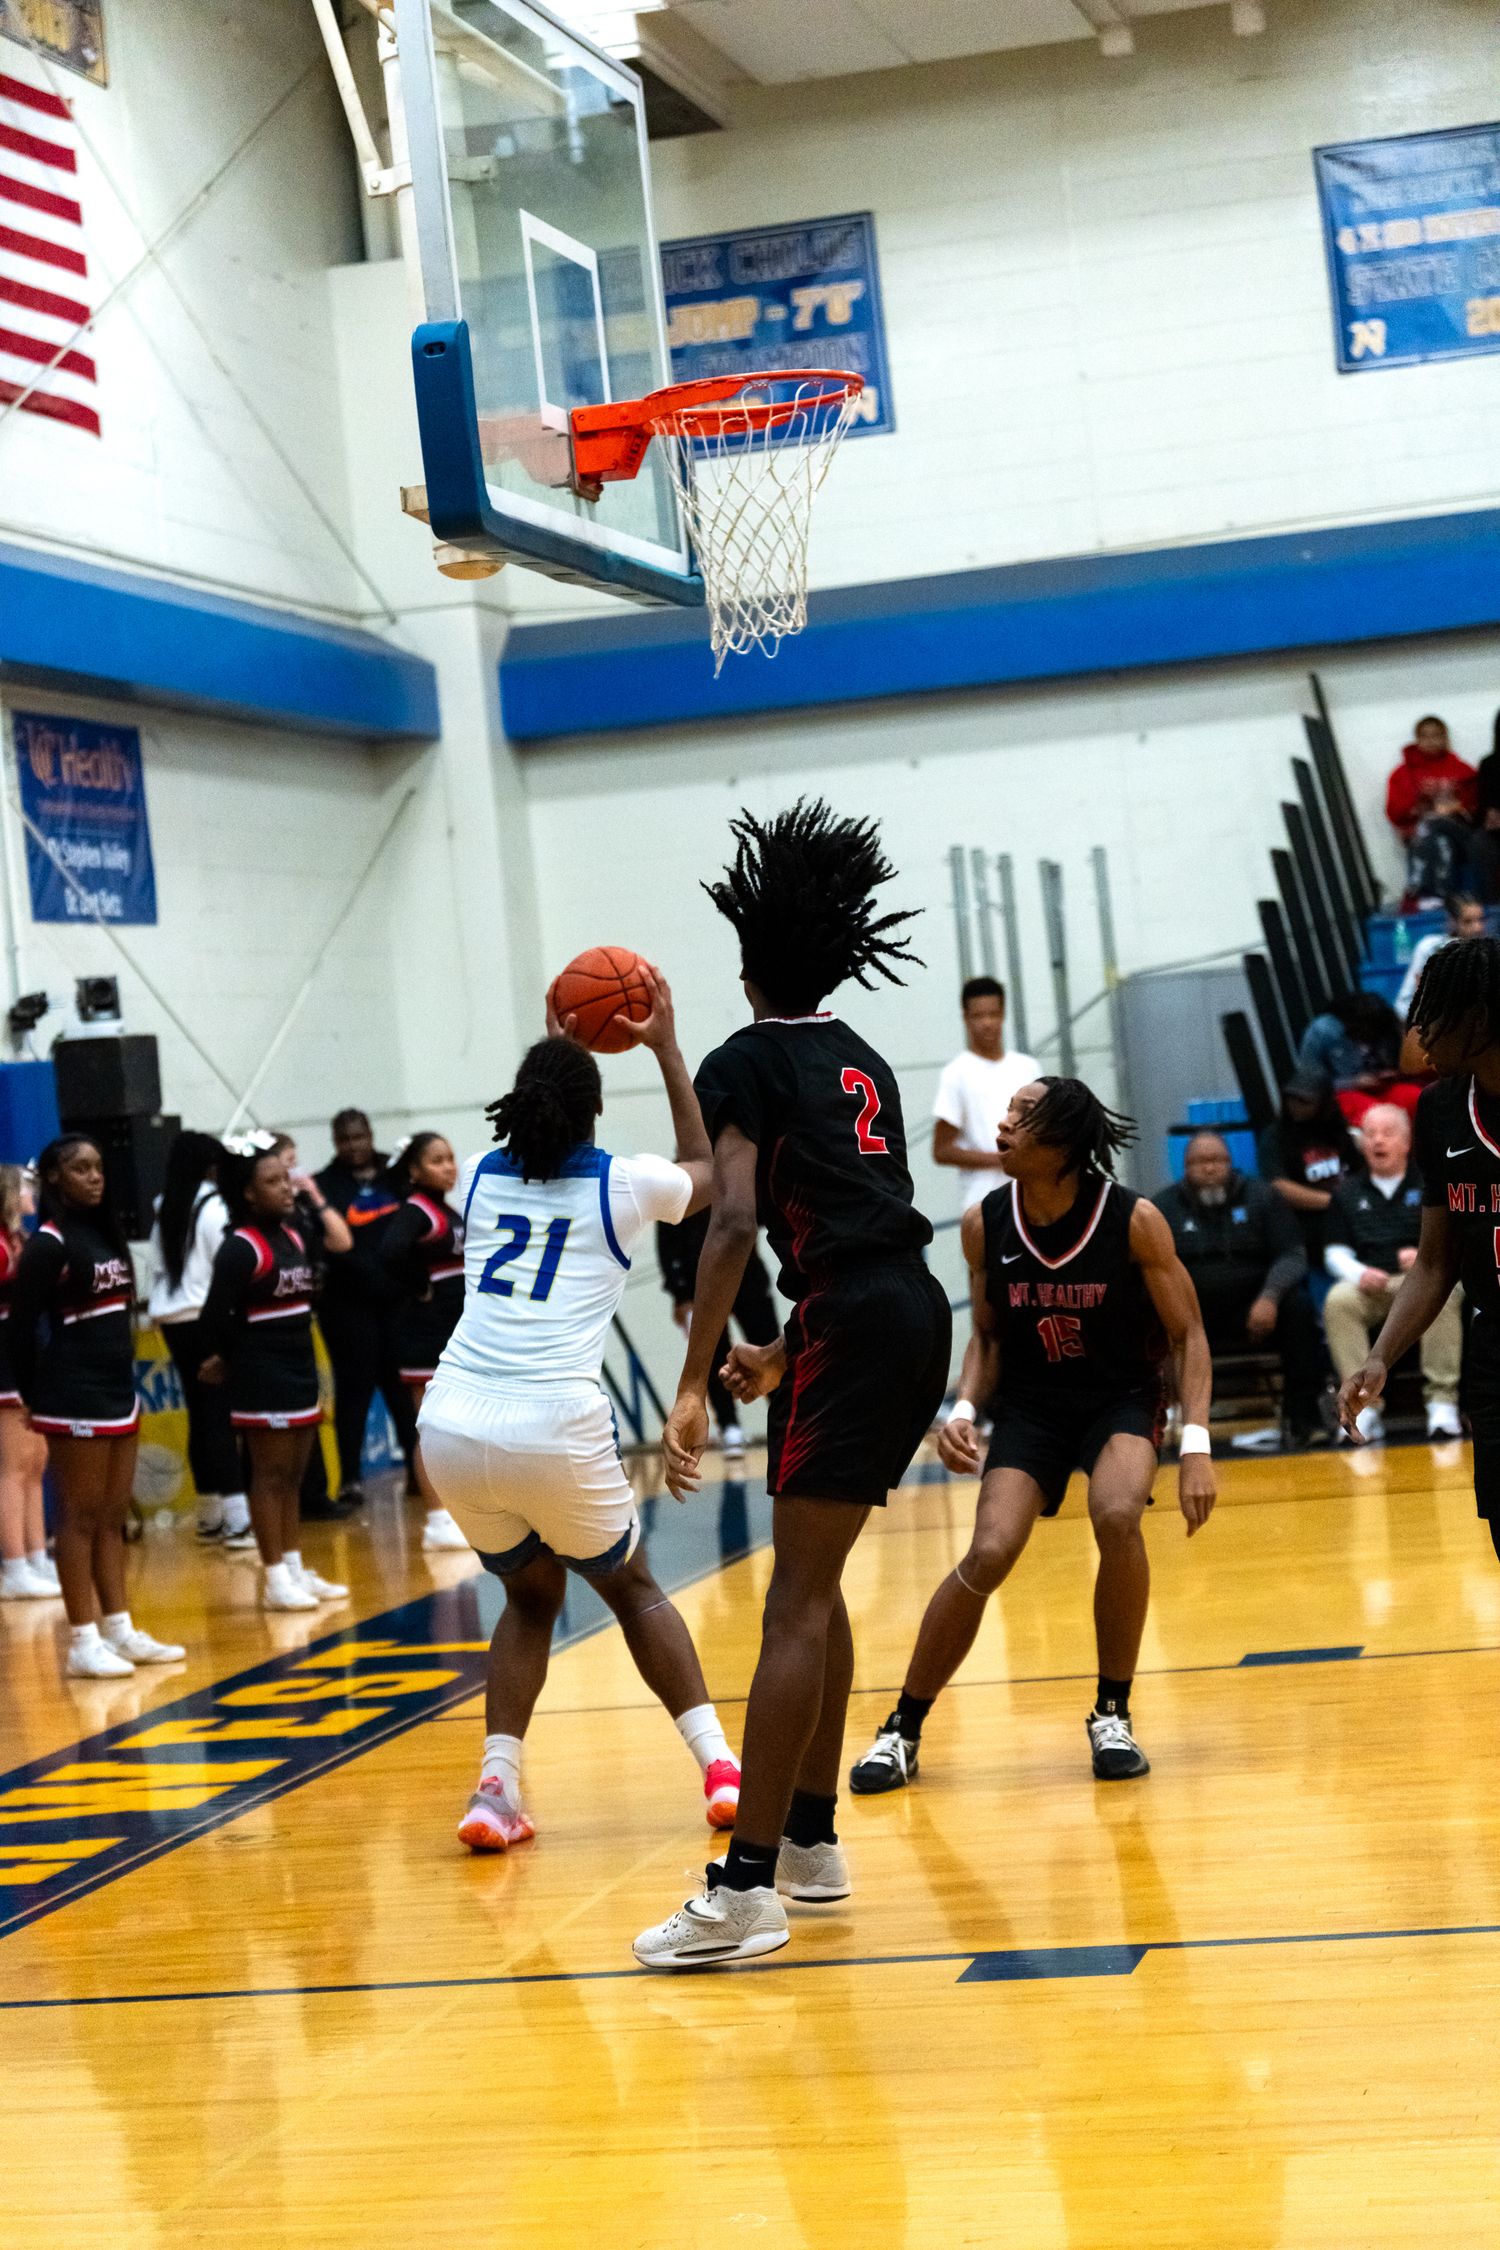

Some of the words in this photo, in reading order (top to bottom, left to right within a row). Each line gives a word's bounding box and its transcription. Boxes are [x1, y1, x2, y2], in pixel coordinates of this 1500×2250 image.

[840, 1067, 890, 1154] 2
[1447, 1183, 1486, 1212] MT.
[477, 1213, 573, 1302] 21
[1008, 1282, 1037, 1307] MT.
[1036, 1283, 1108, 1309] HEALTHY
[1036, 1314, 1086, 1362] 15
